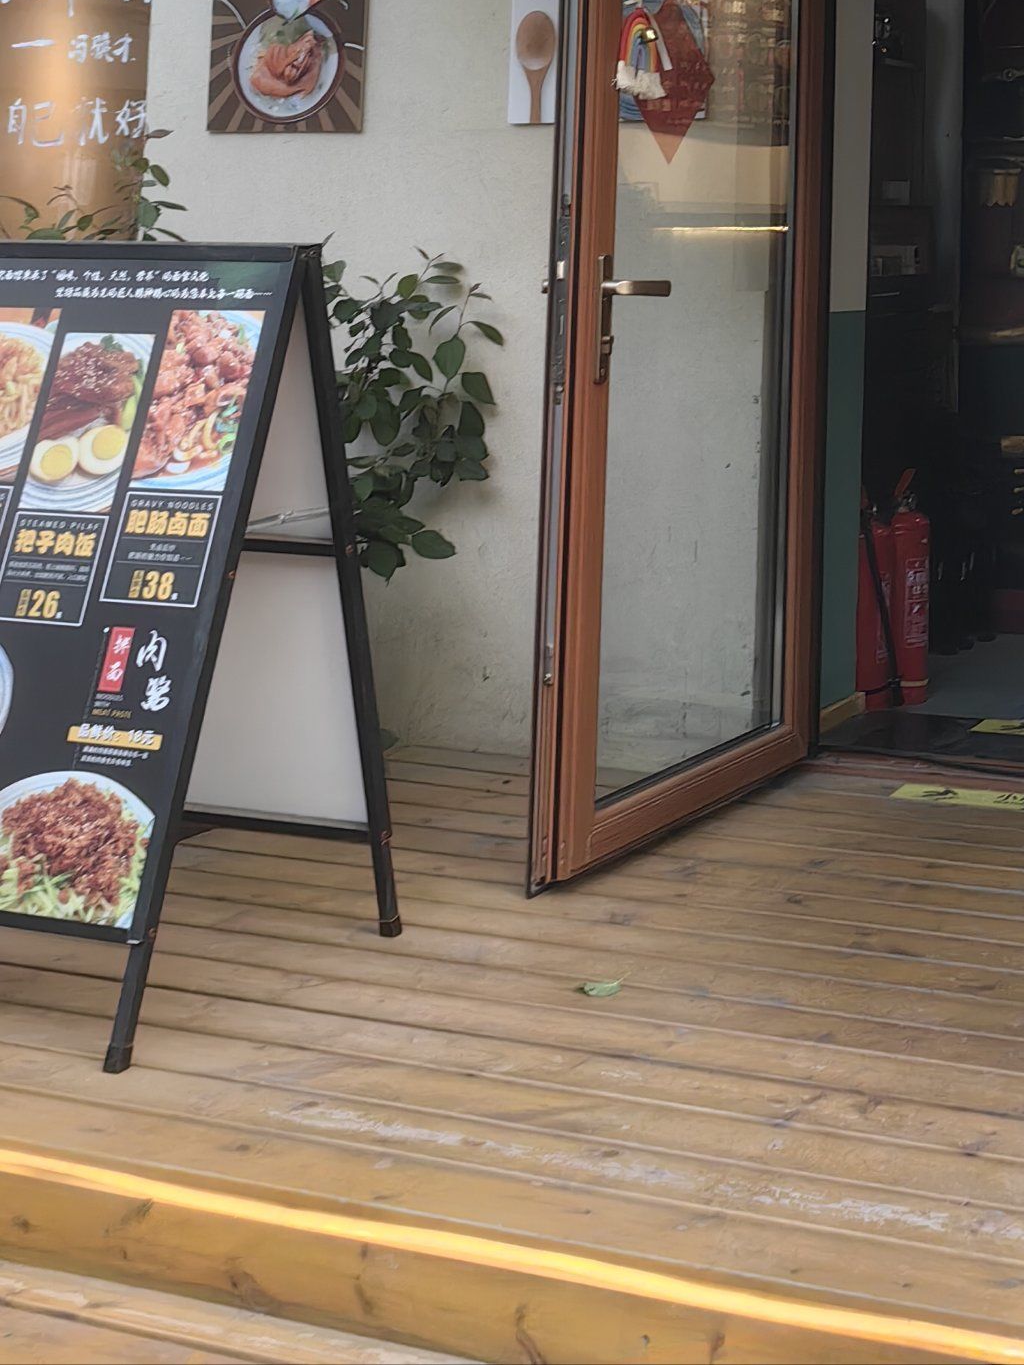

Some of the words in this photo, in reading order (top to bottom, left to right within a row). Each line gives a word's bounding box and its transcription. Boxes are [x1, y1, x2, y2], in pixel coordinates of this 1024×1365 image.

[167, 500, 214, 511] NOODLES
[124, 509, 212, 538] 肥肠卤面
[13, 528, 98, 558] 把子肉饭
